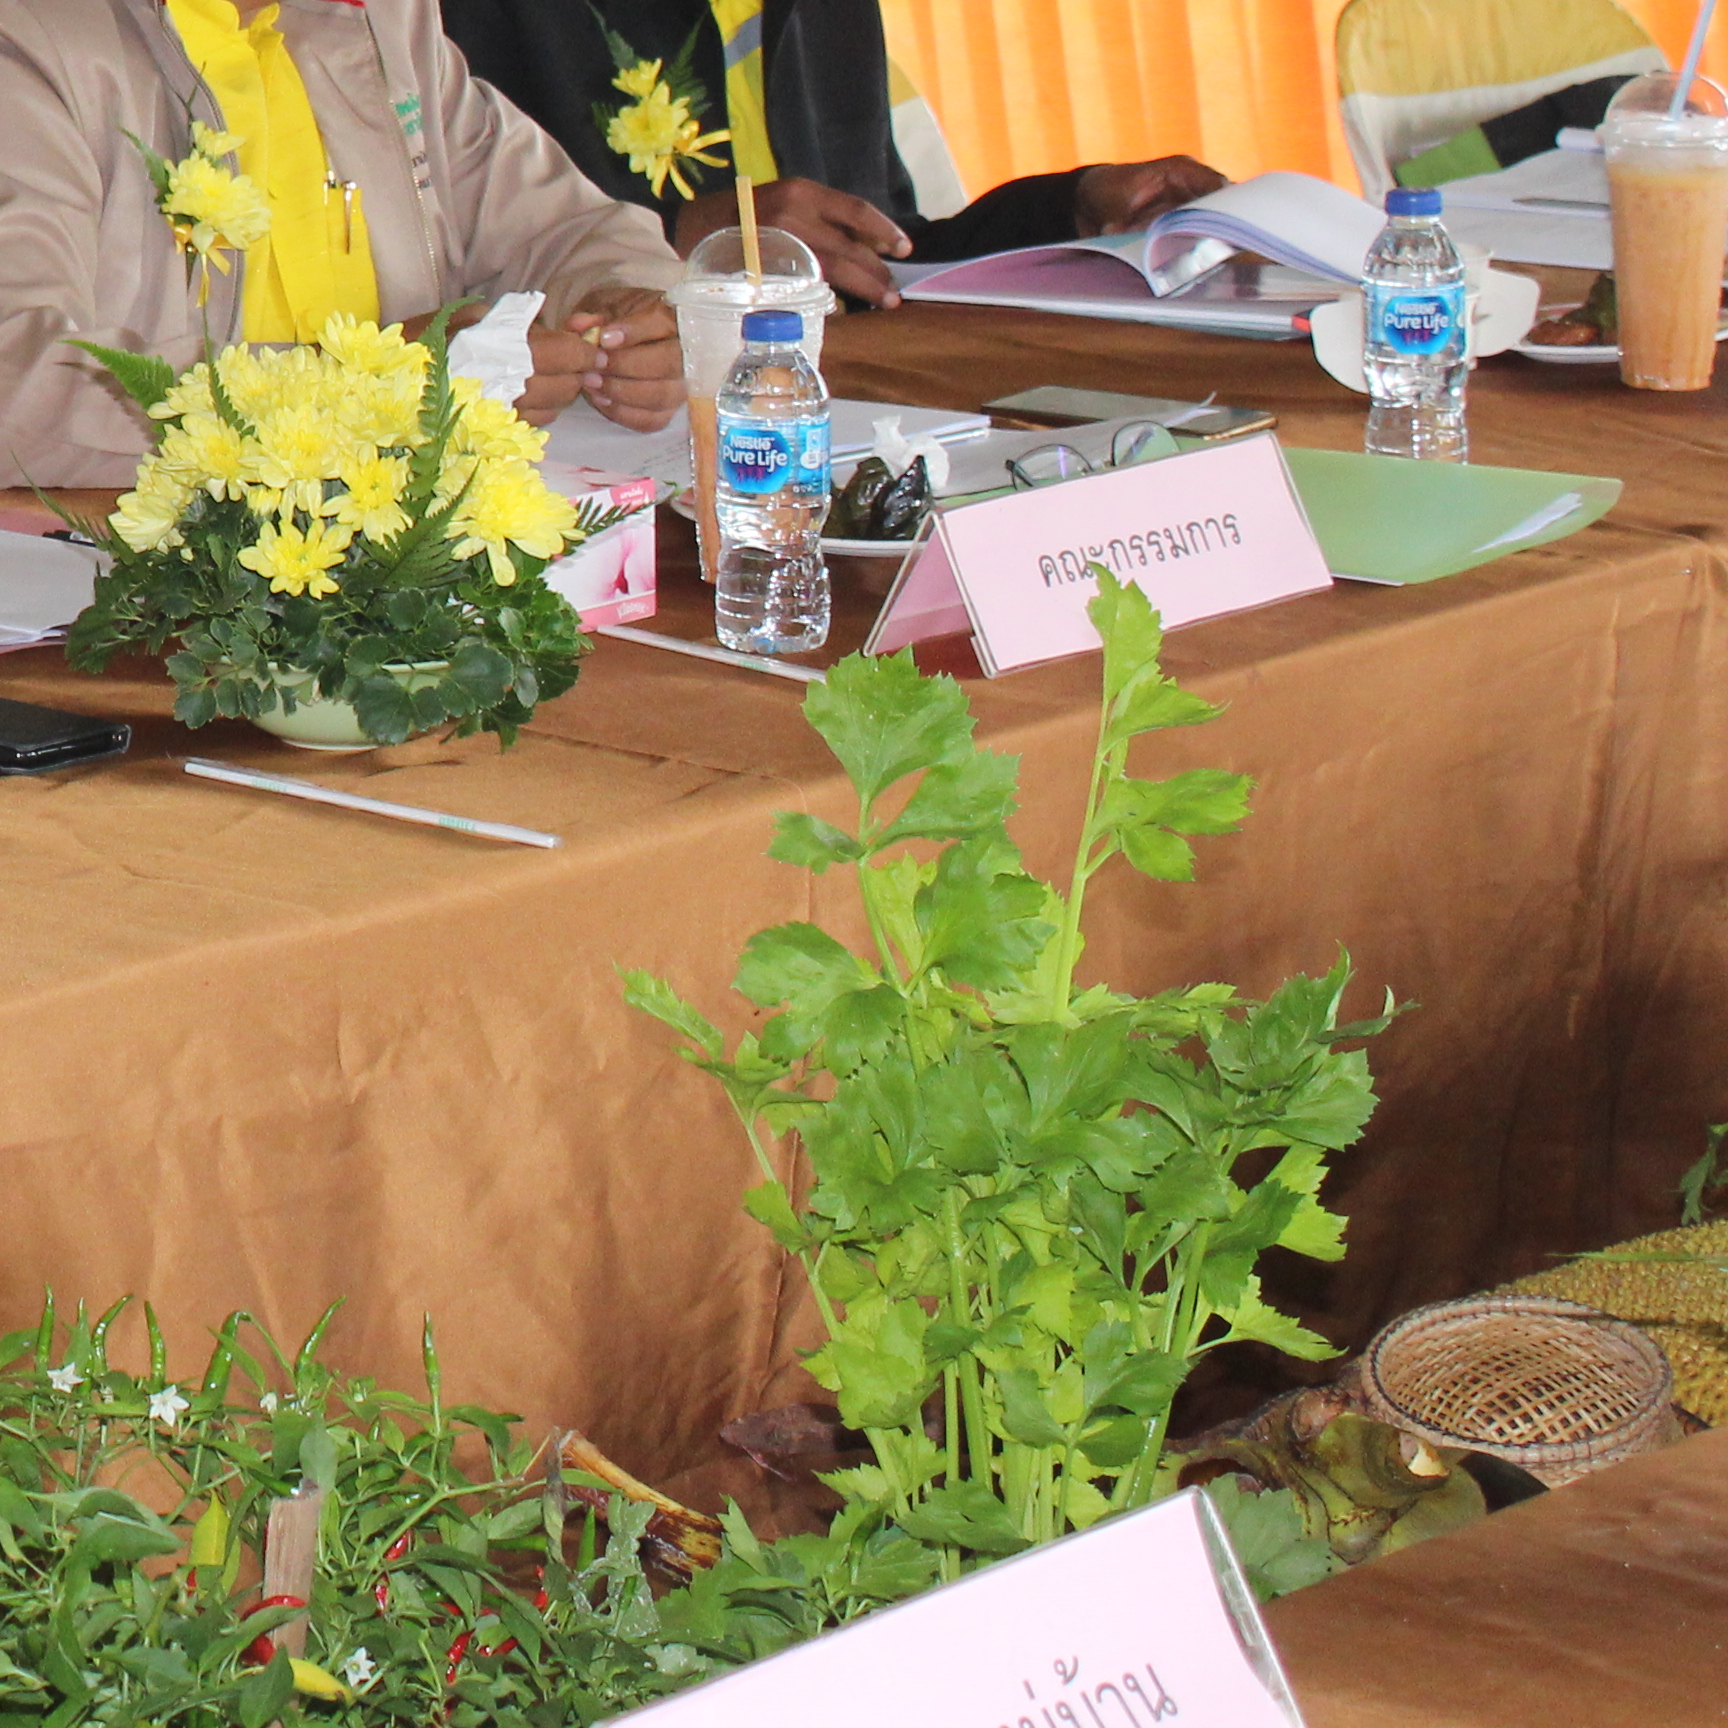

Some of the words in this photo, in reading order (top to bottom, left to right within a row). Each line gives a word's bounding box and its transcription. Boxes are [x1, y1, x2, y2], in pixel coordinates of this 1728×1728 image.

[1384, 313, 1420, 332] Pure
[1422, 313, 1448, 334] Life
[723, 444, 755, 466] Pure
[757, 449, 788, 472] Life
[1038, 512, 1243, 588] คณะกรรมการ
